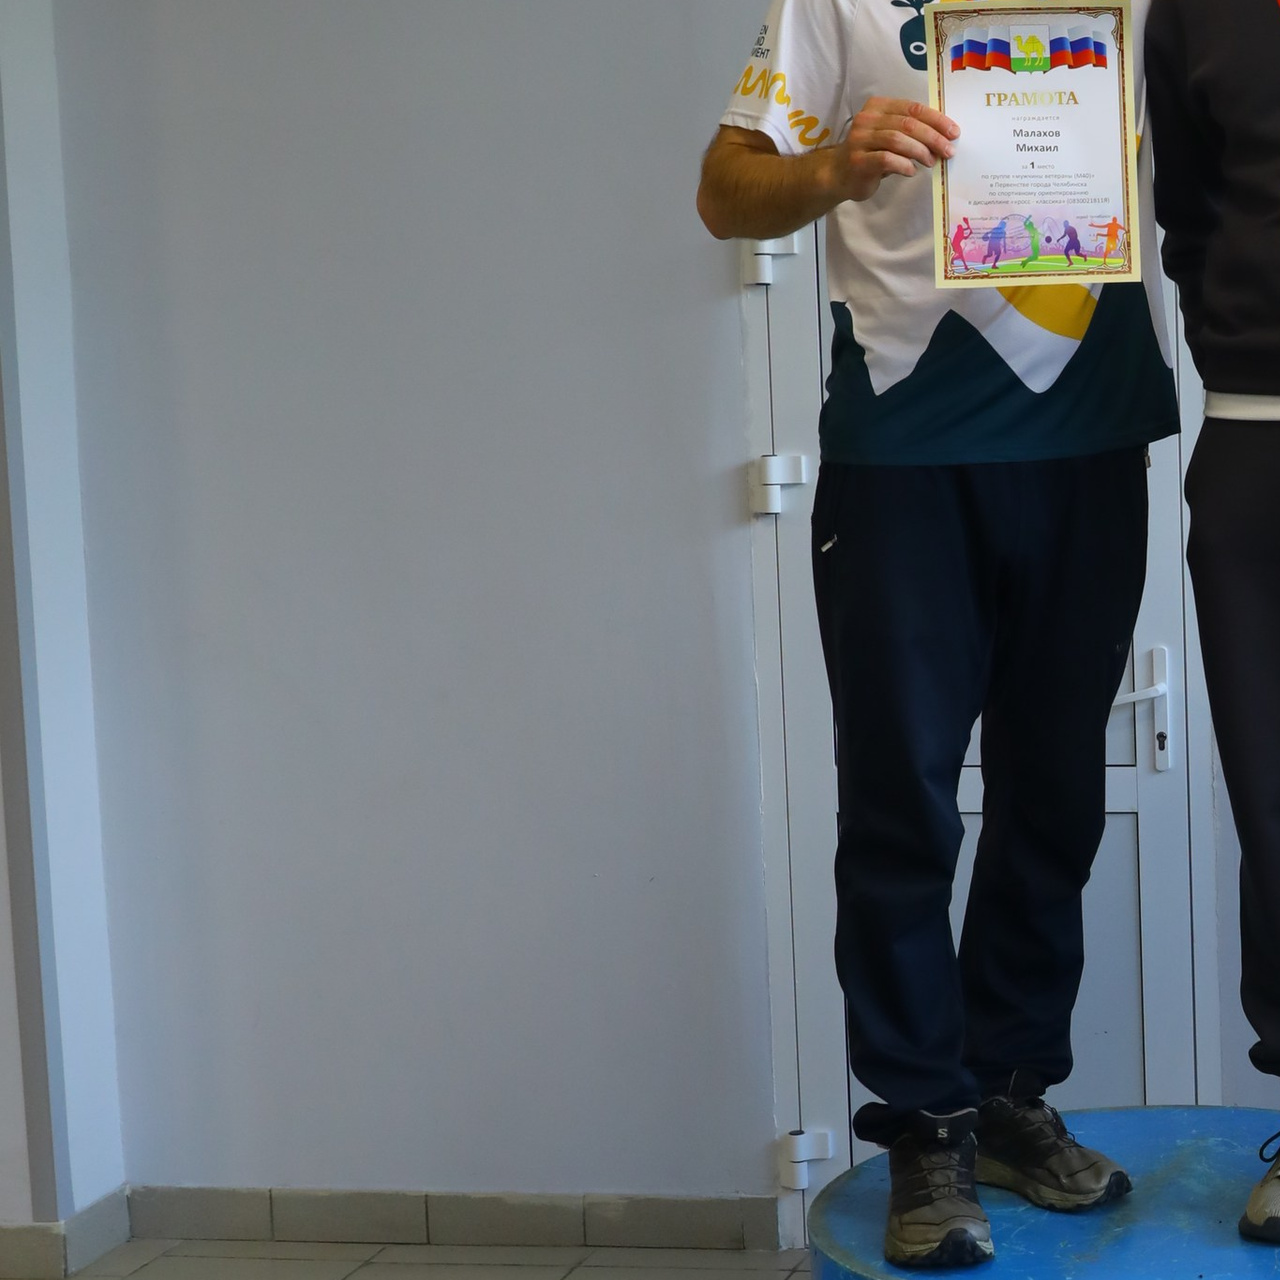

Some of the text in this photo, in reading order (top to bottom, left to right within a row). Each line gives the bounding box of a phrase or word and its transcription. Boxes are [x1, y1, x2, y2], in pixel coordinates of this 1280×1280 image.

[984, 90, 1079, 107] ГРАМОТА
[1012, 128, 1061, 138] Малахов
[1016, 143, 1059, 153] Михаил
[1029, 162, 1036, 170] 1
[937, 1128, 948, 1138] S
